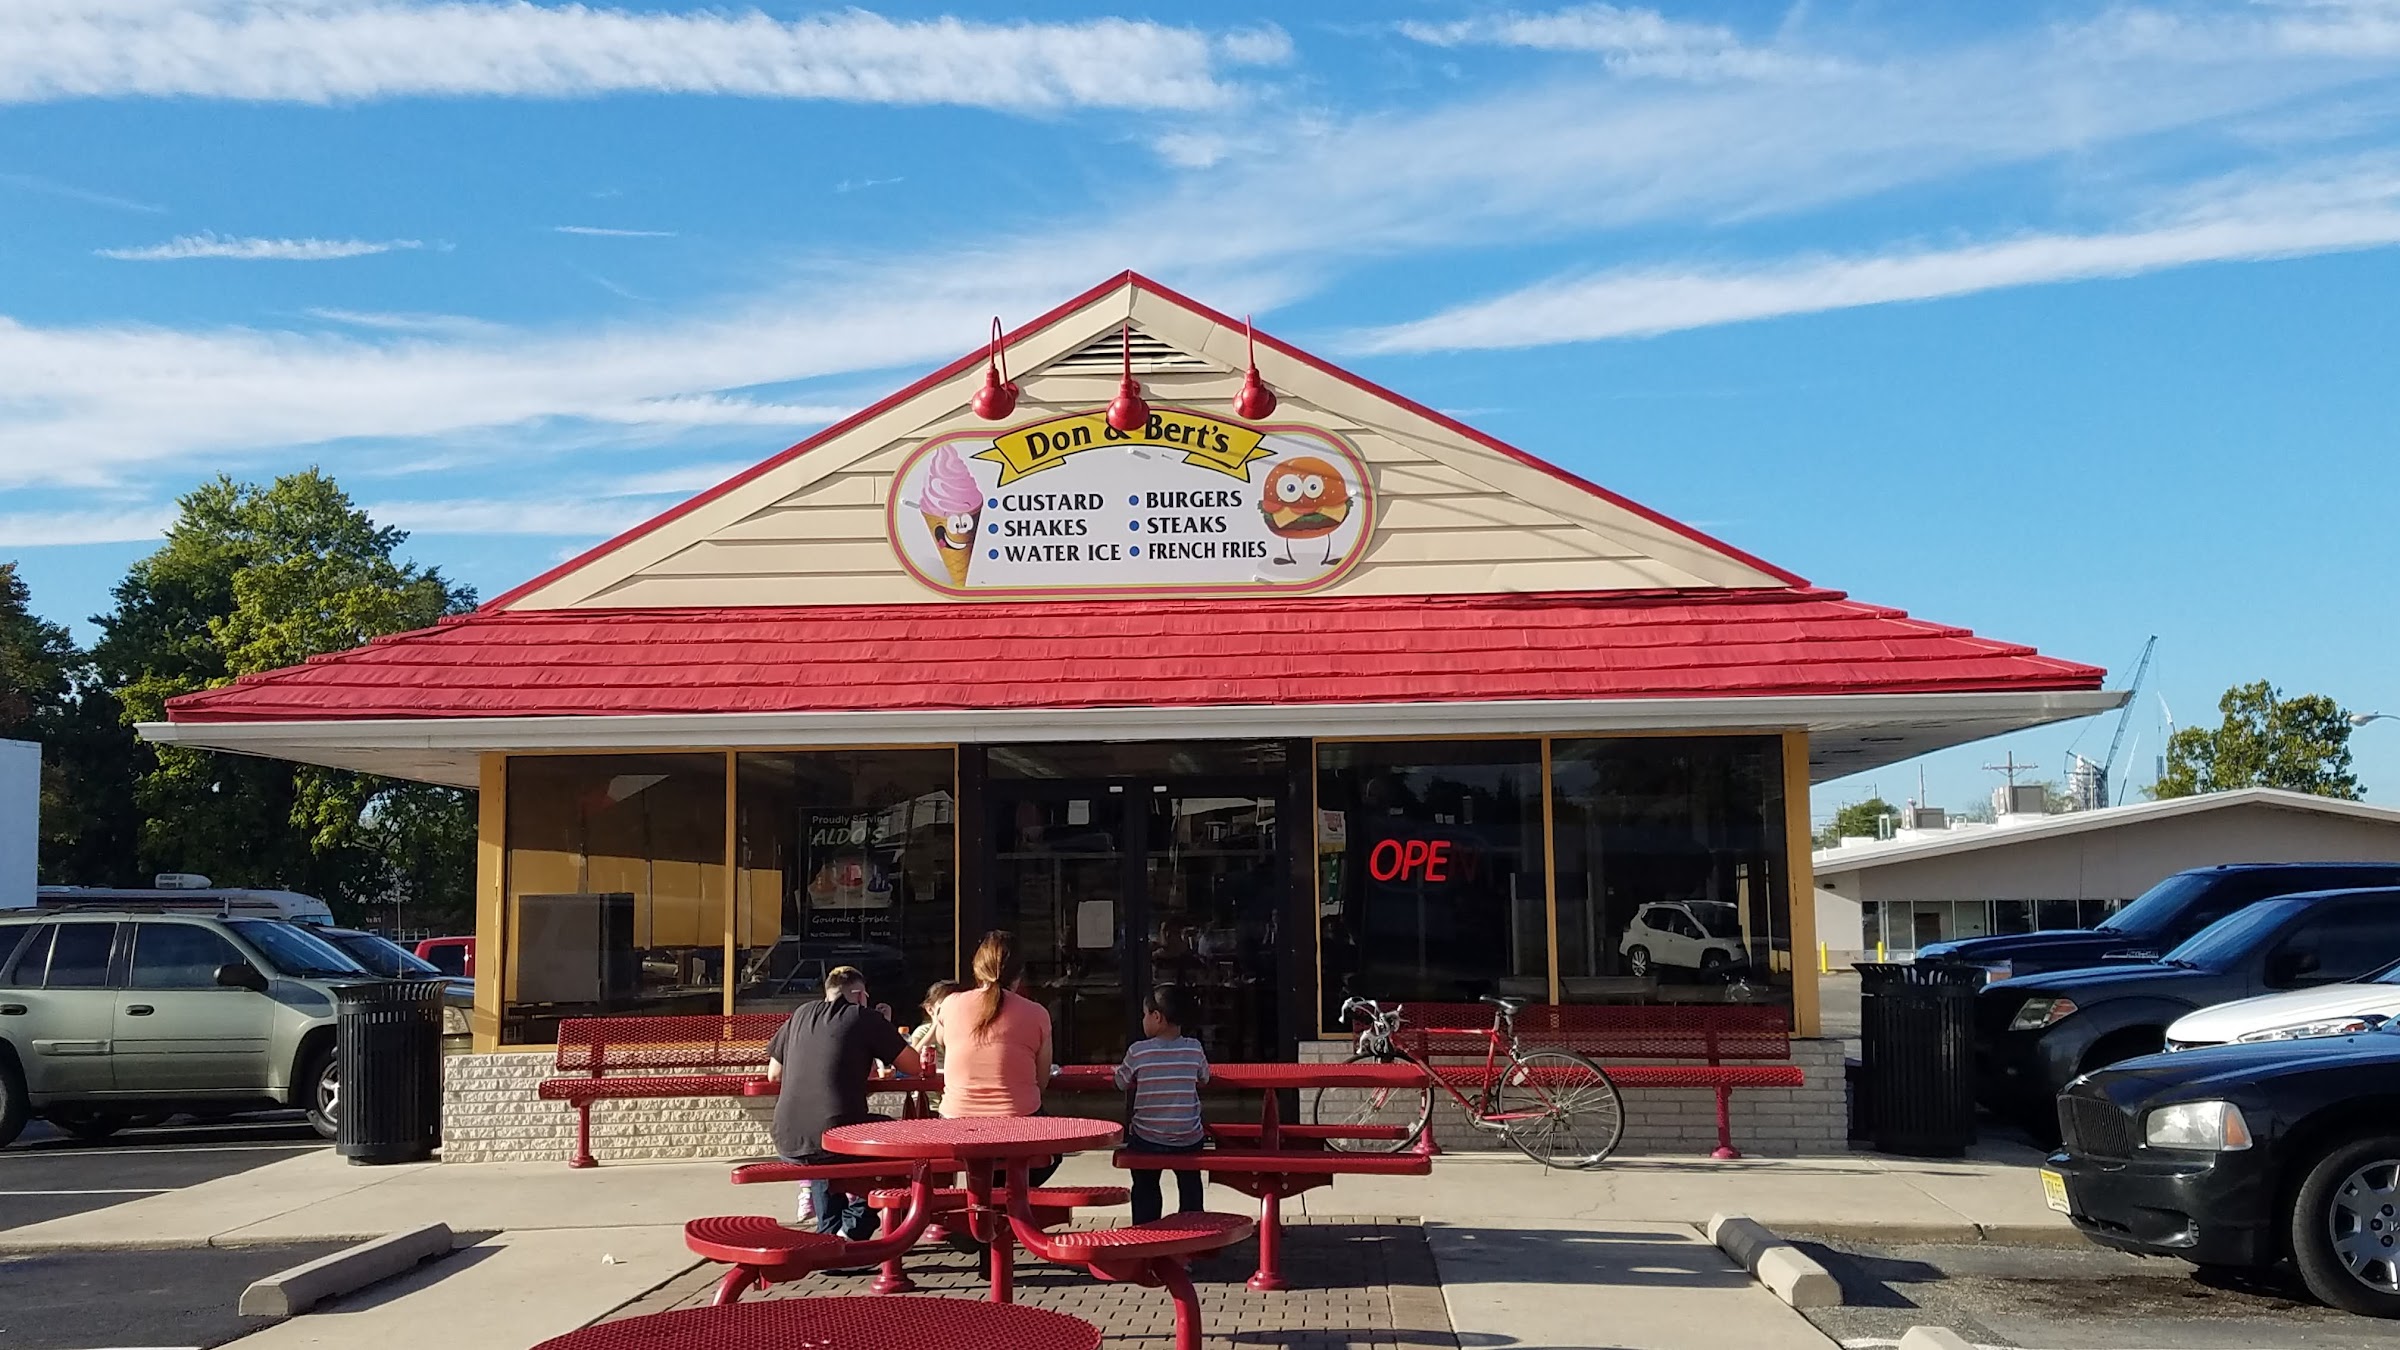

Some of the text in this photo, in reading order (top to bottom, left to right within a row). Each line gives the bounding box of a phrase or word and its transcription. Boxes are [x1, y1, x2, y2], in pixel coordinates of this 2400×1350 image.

[1024, 425, 1092, 461] Don
[1143, 413, 1230, 454] Bert's
[1002, 493, 1104, 512] CUSTARD
[1146, 490, 1243, 509] BURGERS
[1004, 519, 1088, 537] SHAKES
[1146, 516, 1227, 534] STEAKS
[1004, 544, 1122, 562] WATER ICE
[1148, 541, 1267, 560] FRENCH FRIES
[812, 814, 888, 826] Proudly Servin
[811, 827, 885, 848] ALDO'S
